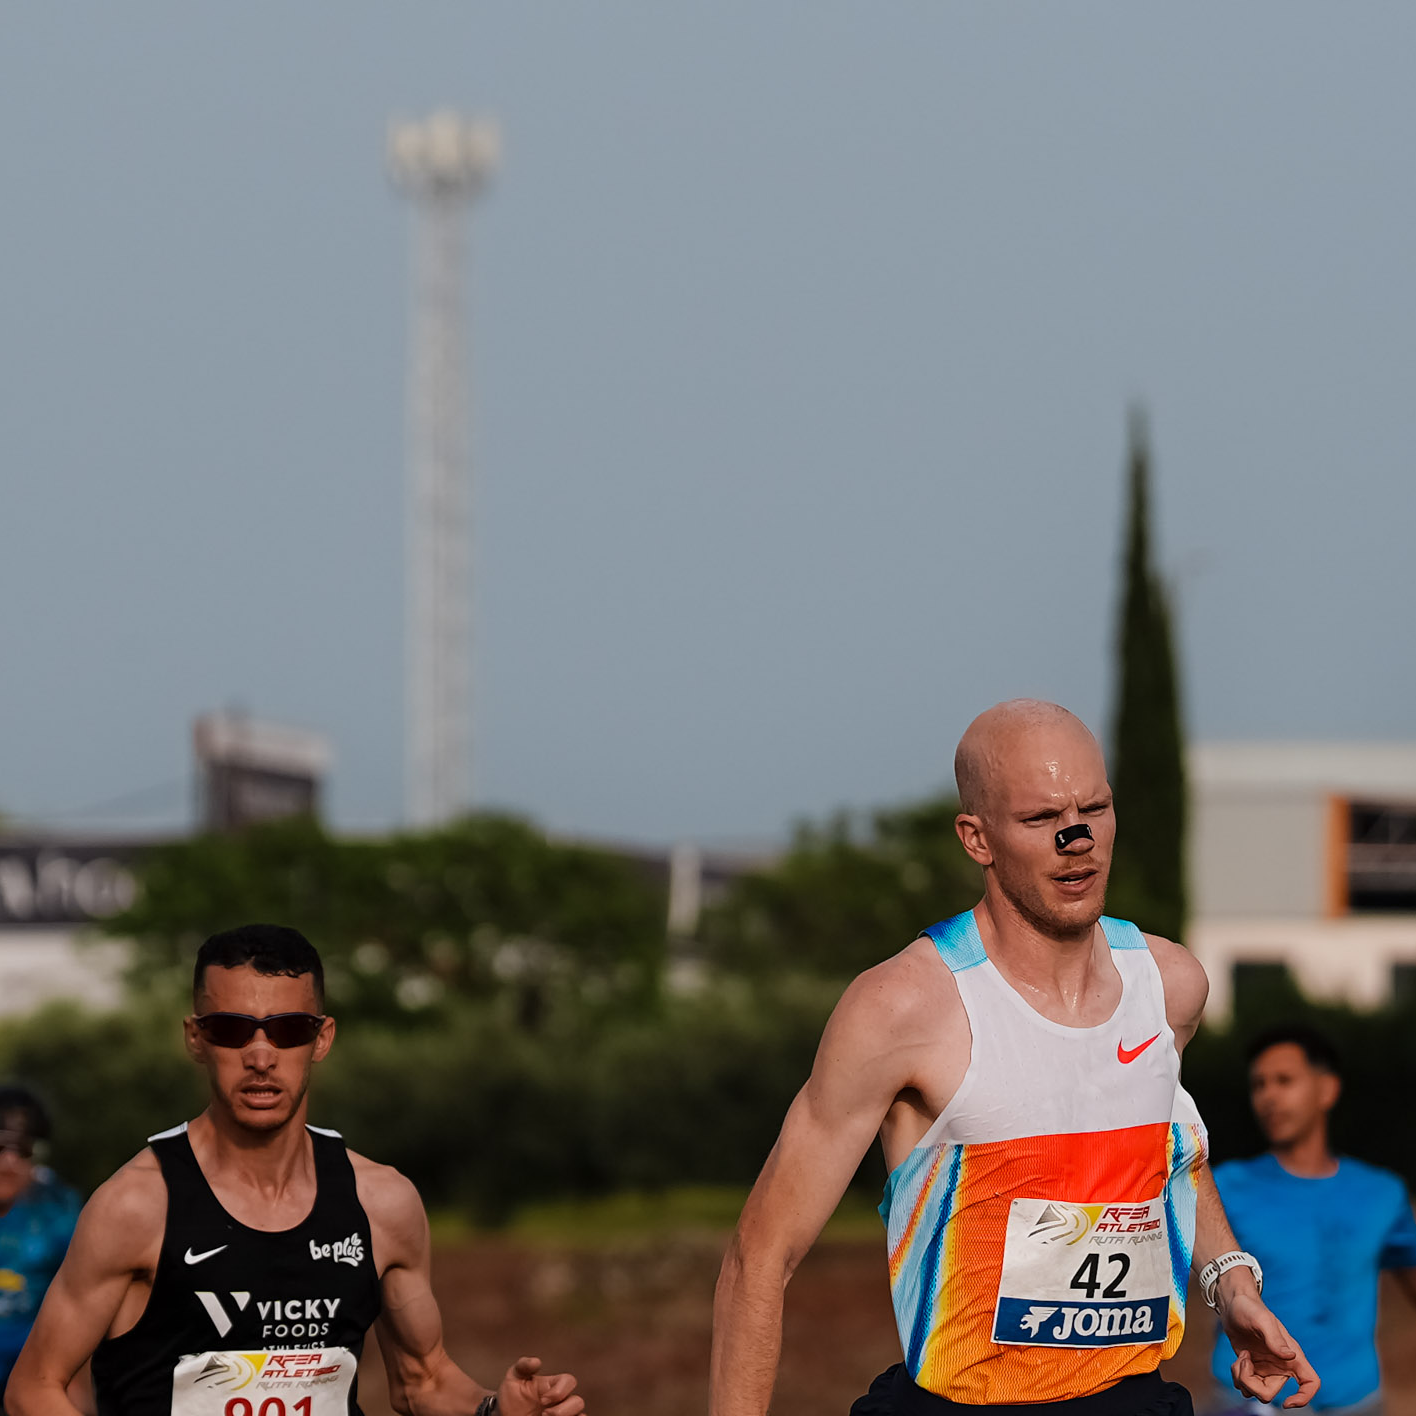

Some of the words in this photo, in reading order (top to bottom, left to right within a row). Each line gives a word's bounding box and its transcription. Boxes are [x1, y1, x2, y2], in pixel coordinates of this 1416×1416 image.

[1102, 1206, 1150, 1222] RFEA
[1089, 1236, 1124, 1246] RUTA
[1128, 1231, 1163, 1246] RUNNING
[309, 1239, 331, 1260] be
[1070, 1253, 1131, 1299] 42
[256, 1298, 341, 1321] VICKY
[262, 1322, 330, 1339] FOODS
[267, 1353, 323, 1369] RFEA
[256, 1380, 294, 1390] RUTA
